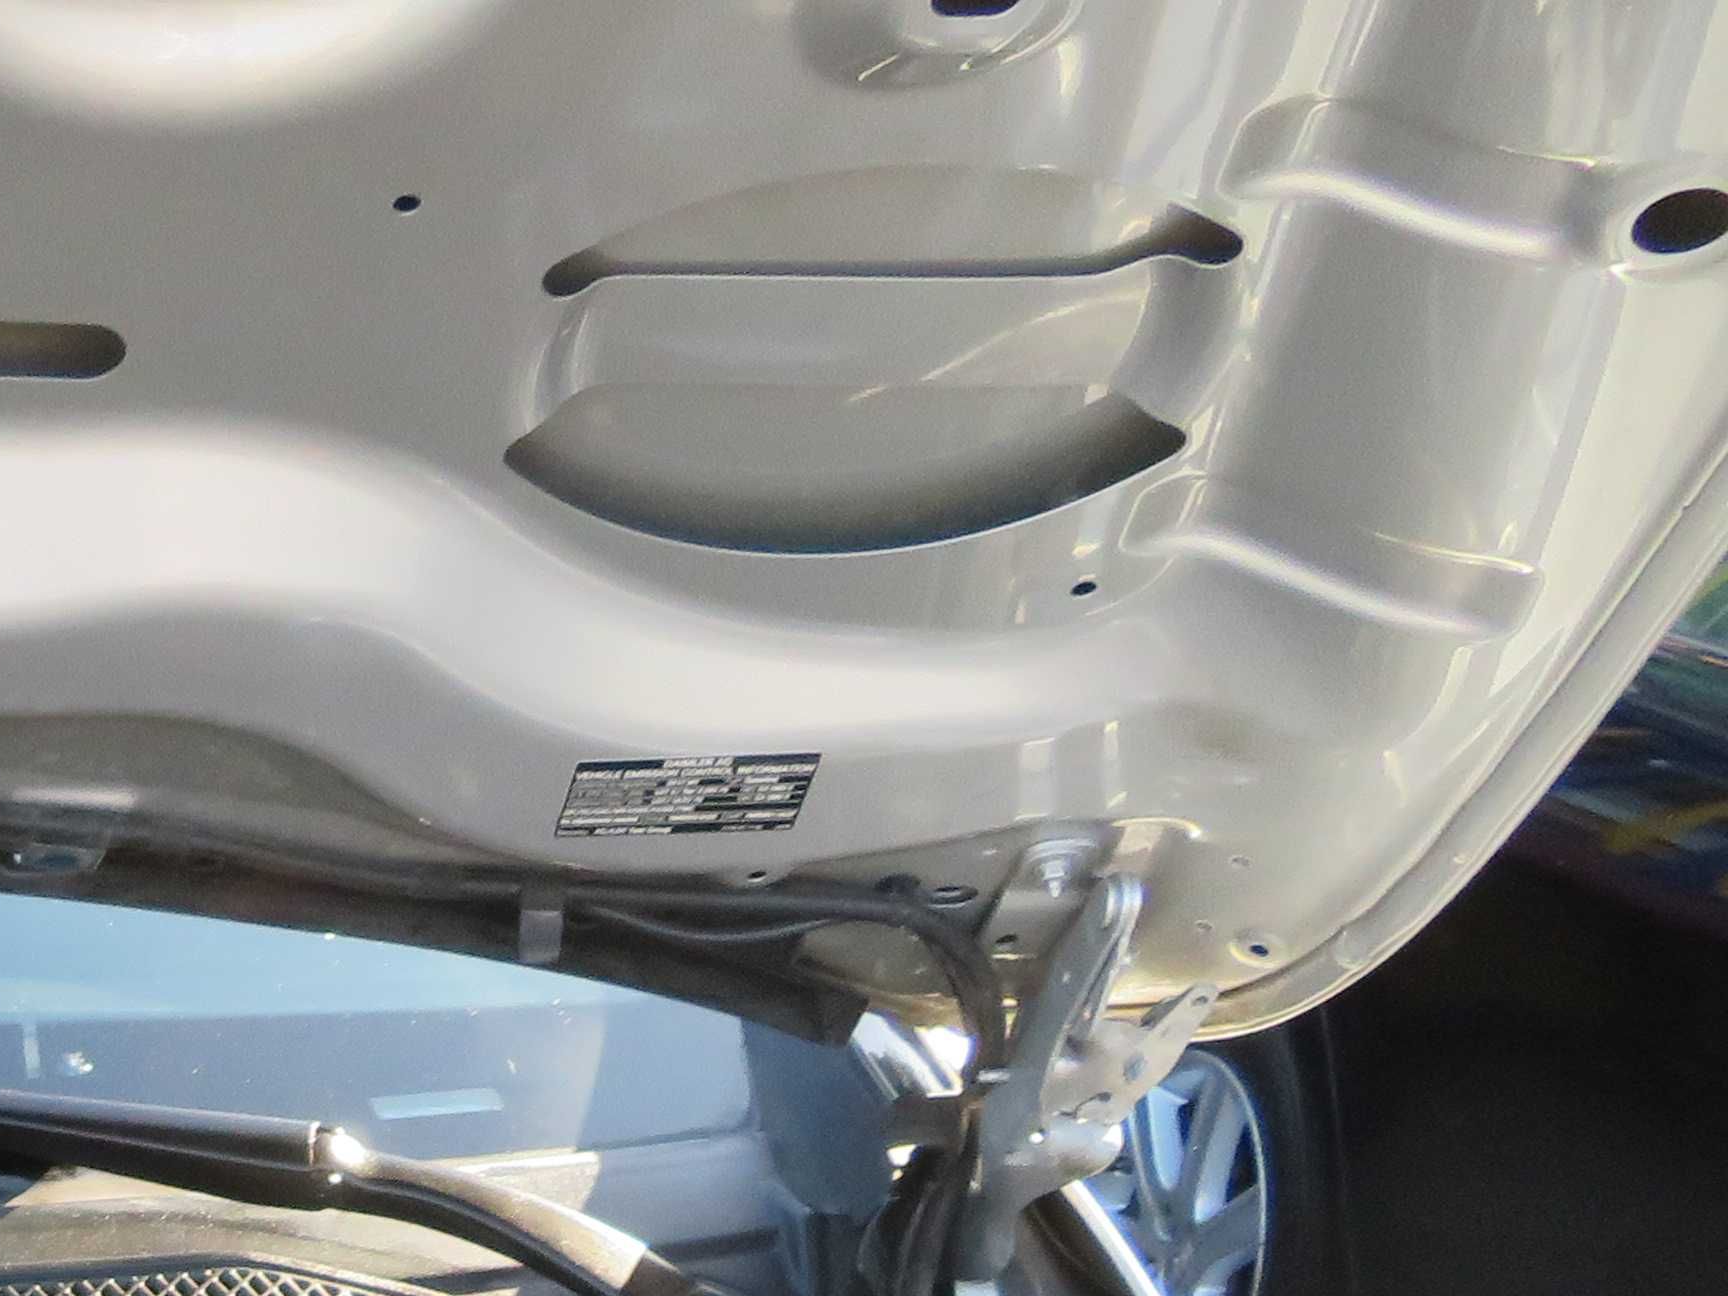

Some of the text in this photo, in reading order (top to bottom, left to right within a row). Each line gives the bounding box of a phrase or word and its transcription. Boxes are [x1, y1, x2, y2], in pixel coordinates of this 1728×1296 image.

[576, 763, 817, 781] VEHICLE EMISSION CONTROL INFORMATION
